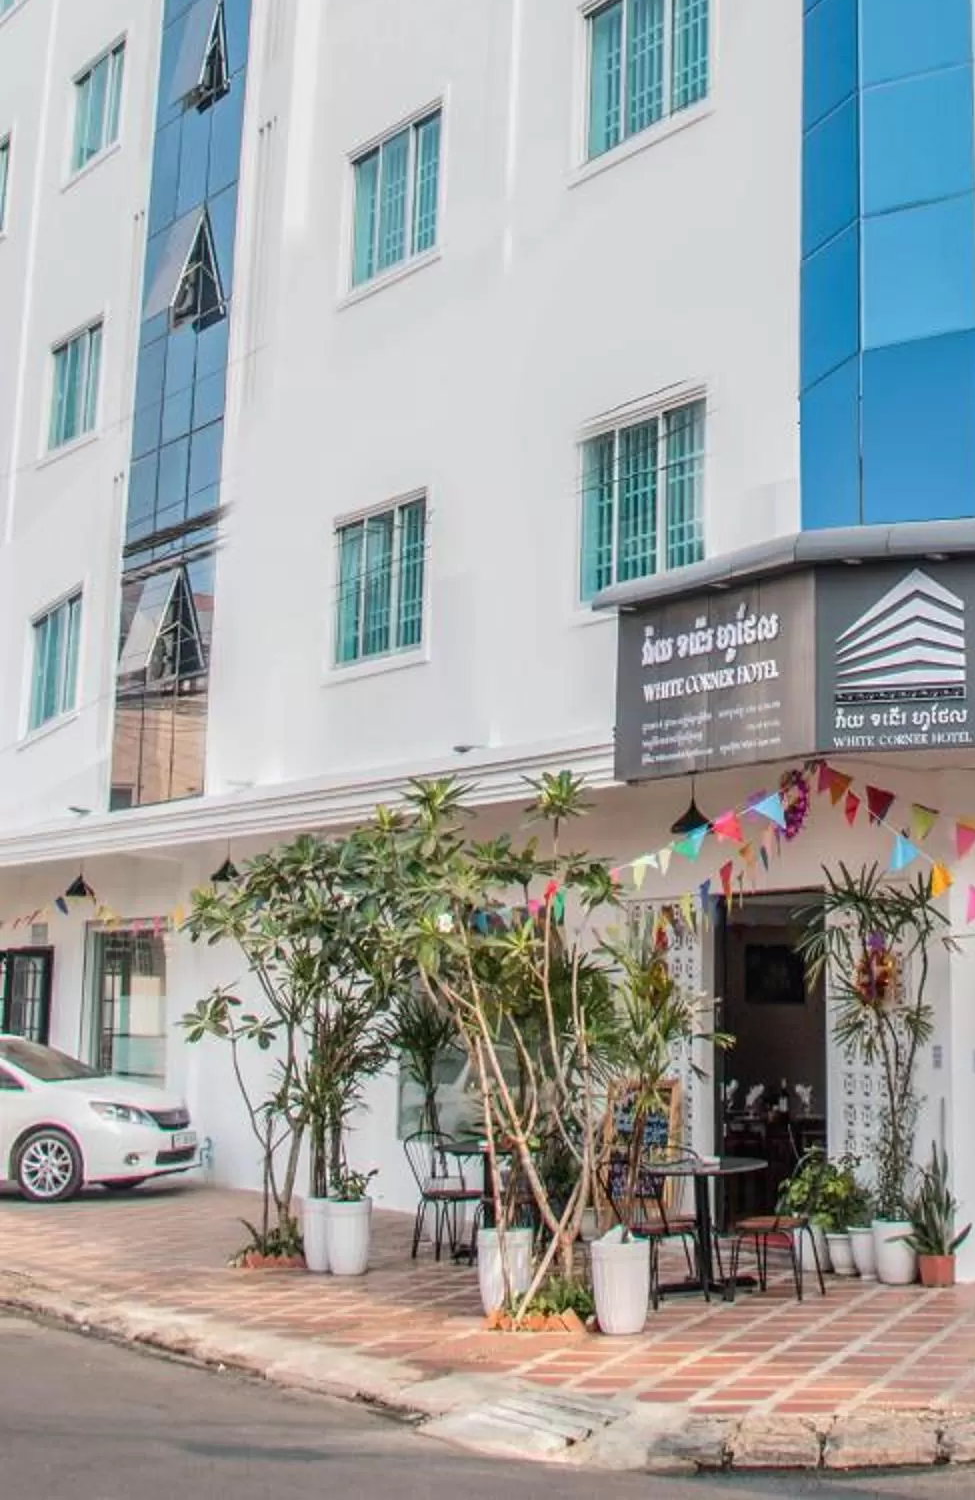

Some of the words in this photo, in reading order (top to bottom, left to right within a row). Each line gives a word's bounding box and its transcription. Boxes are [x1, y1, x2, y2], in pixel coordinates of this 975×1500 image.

[642, 677, 685, 703] WHITE
[685, 668, 735, 694] CORNER
[737, 659, 779, 684] HOTEL
[833, 735, 875, 748] WHITE
[879, 733, 928, 746] CORNER
[932, 731, 973, 744] HOTEL
